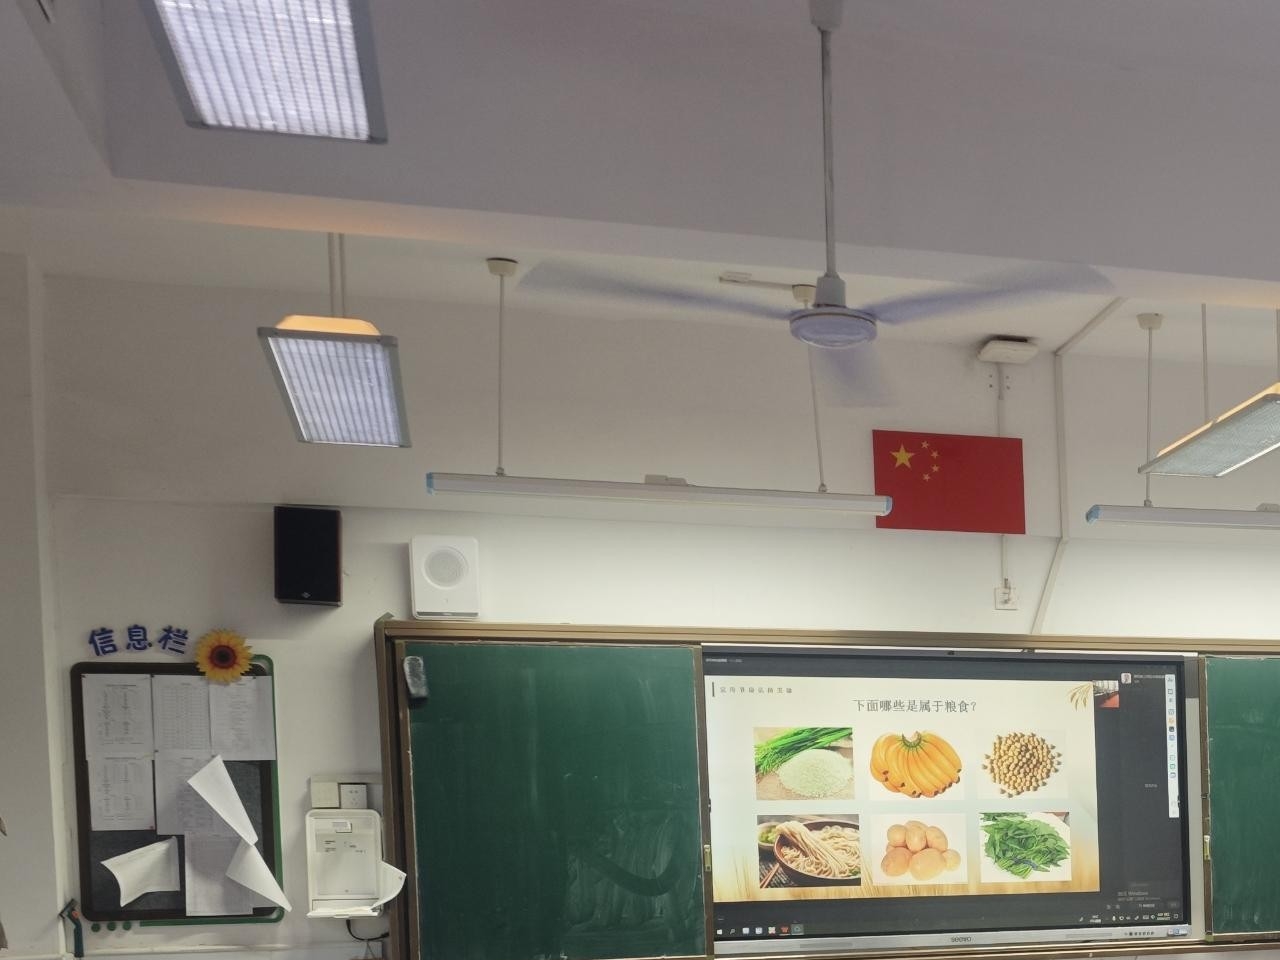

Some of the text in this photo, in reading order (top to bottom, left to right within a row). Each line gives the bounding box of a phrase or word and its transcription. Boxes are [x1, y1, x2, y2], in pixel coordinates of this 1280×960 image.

[88, 623, 189, 657] 信息栏
[852, 698, 977, 713] 下面哪些是属于粮食？
